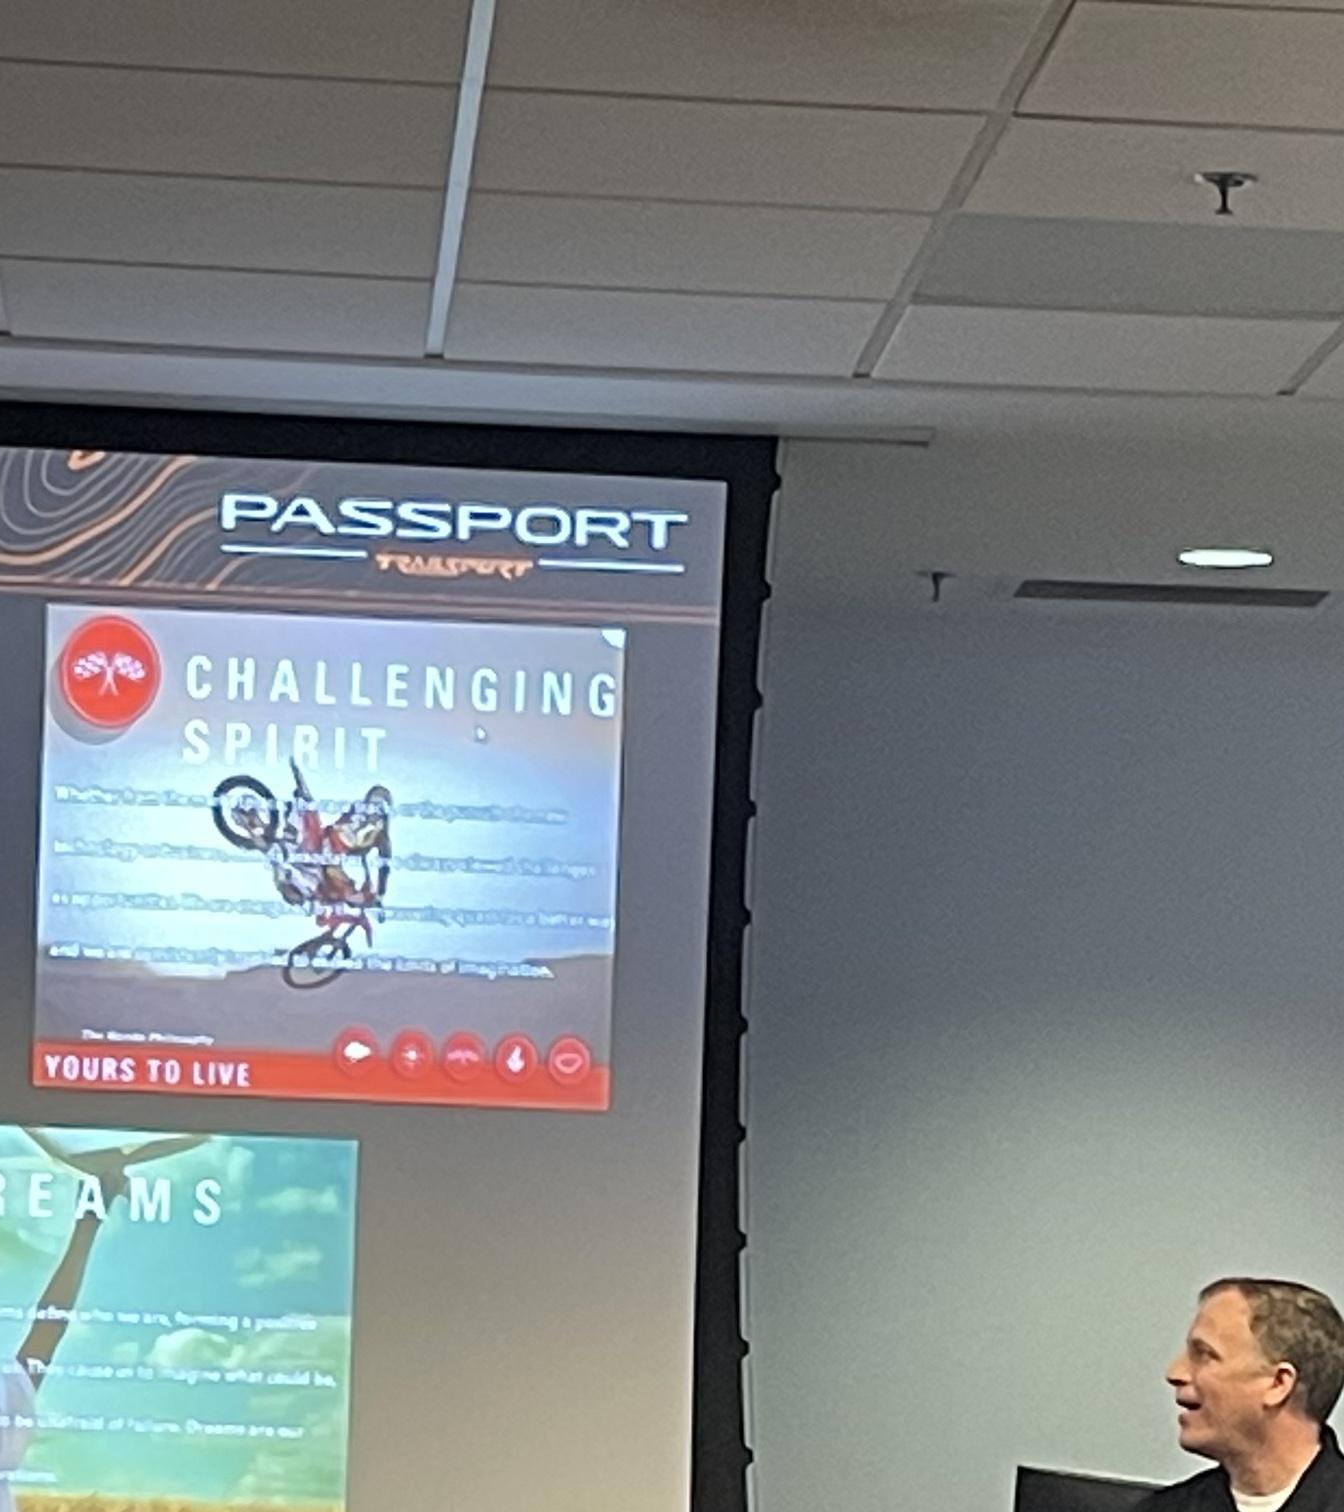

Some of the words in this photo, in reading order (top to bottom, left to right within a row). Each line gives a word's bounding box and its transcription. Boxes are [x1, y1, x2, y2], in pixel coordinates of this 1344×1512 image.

[220, 493, 689, 550] PASSPORT
[184, 654, 618, 719] CHALLENGING
[182, 718, 388, 771] SPIRIT
[45, 1055, 136, 1082] YOURS
[147, 1059, 180, 1084] TO
[193, 1062, 249, 1087] LIVE
